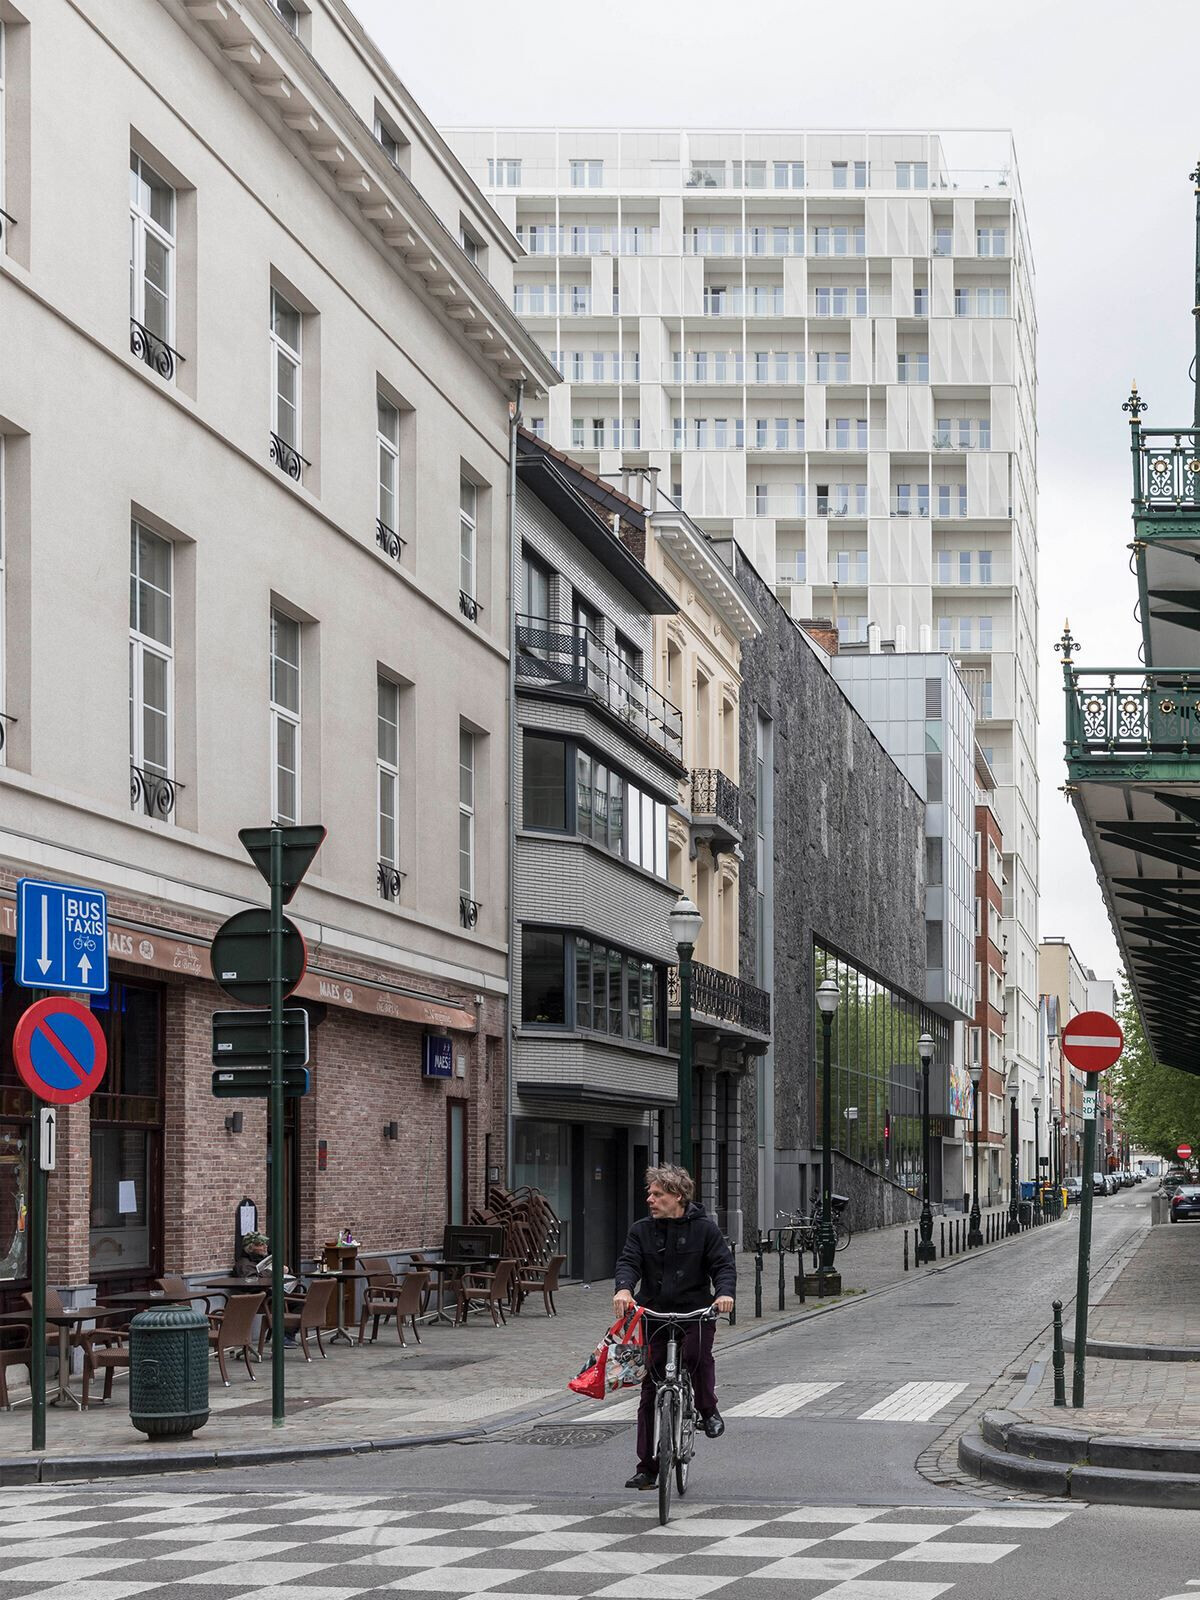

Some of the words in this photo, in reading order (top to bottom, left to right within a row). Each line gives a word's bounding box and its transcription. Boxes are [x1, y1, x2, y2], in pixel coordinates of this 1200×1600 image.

[67, 899, 100, 920] BUS
[66, 917, 104, 936] TAXIS
[319, 981, 340, 999] MAES
[435, 1055, 449, 1070] MAES
